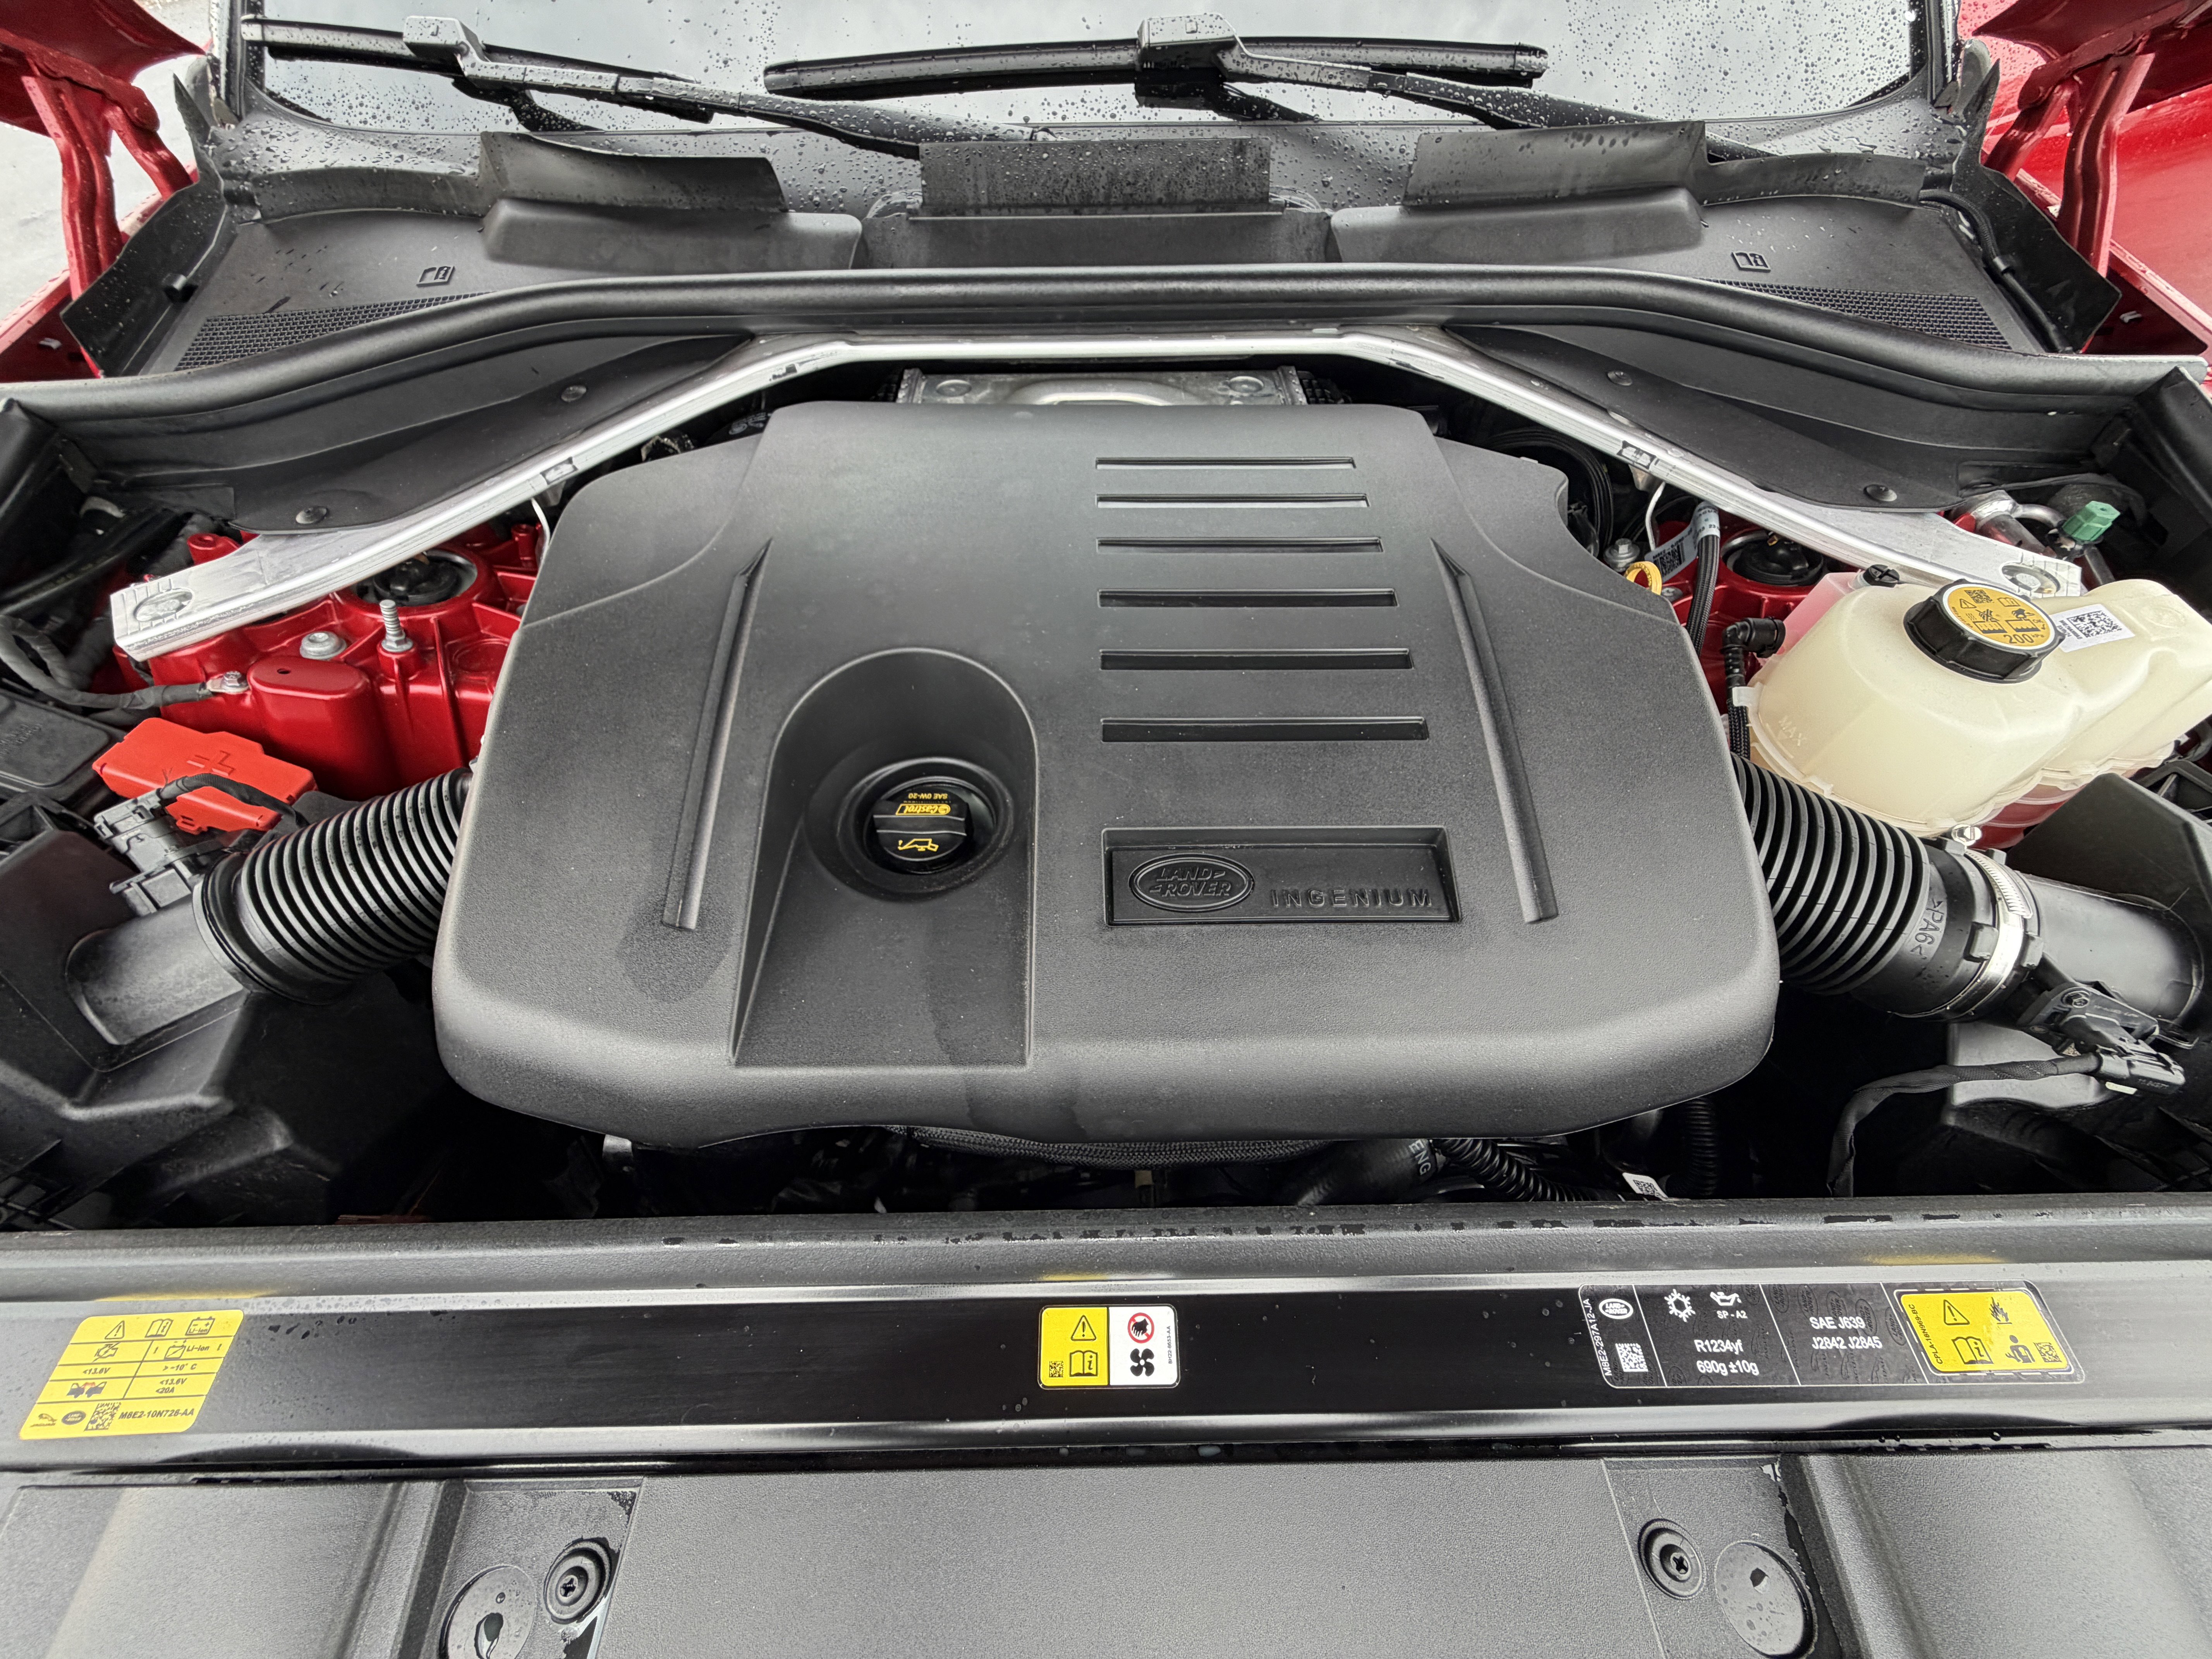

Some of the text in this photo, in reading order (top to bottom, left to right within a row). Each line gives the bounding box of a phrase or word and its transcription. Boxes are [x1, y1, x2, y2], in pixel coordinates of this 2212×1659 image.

[2003, 634, 2034, 644] 200
[903, 805, 938, 814] Castrol
[1160, 866, 1213, 880] LAND
[1162, 881, 1231, 898] ROVER
[1271, 888, 1432, 908] INGENIUM
[1408, 1139, 1431, 1175] ENG
[1717, 1310, 1729, 1319] SP
[1736, 1310, 1748, 1319] A2
[1809, 1317, 1837, 1329] SAE
[1838, 1317, 1866, 1329] J639
[1583, 1298, 1612, 1376] M8E2-297A12-JA
[1909, 1304, 1943, 1365] CPLA-18N969-BC
[1694, 1339, 1744, 1355] R1234yf
[1812, 1336, 1883, 1350] J2842 J2845
[1696, 1360, 1760, 1376] 690g ±10g
